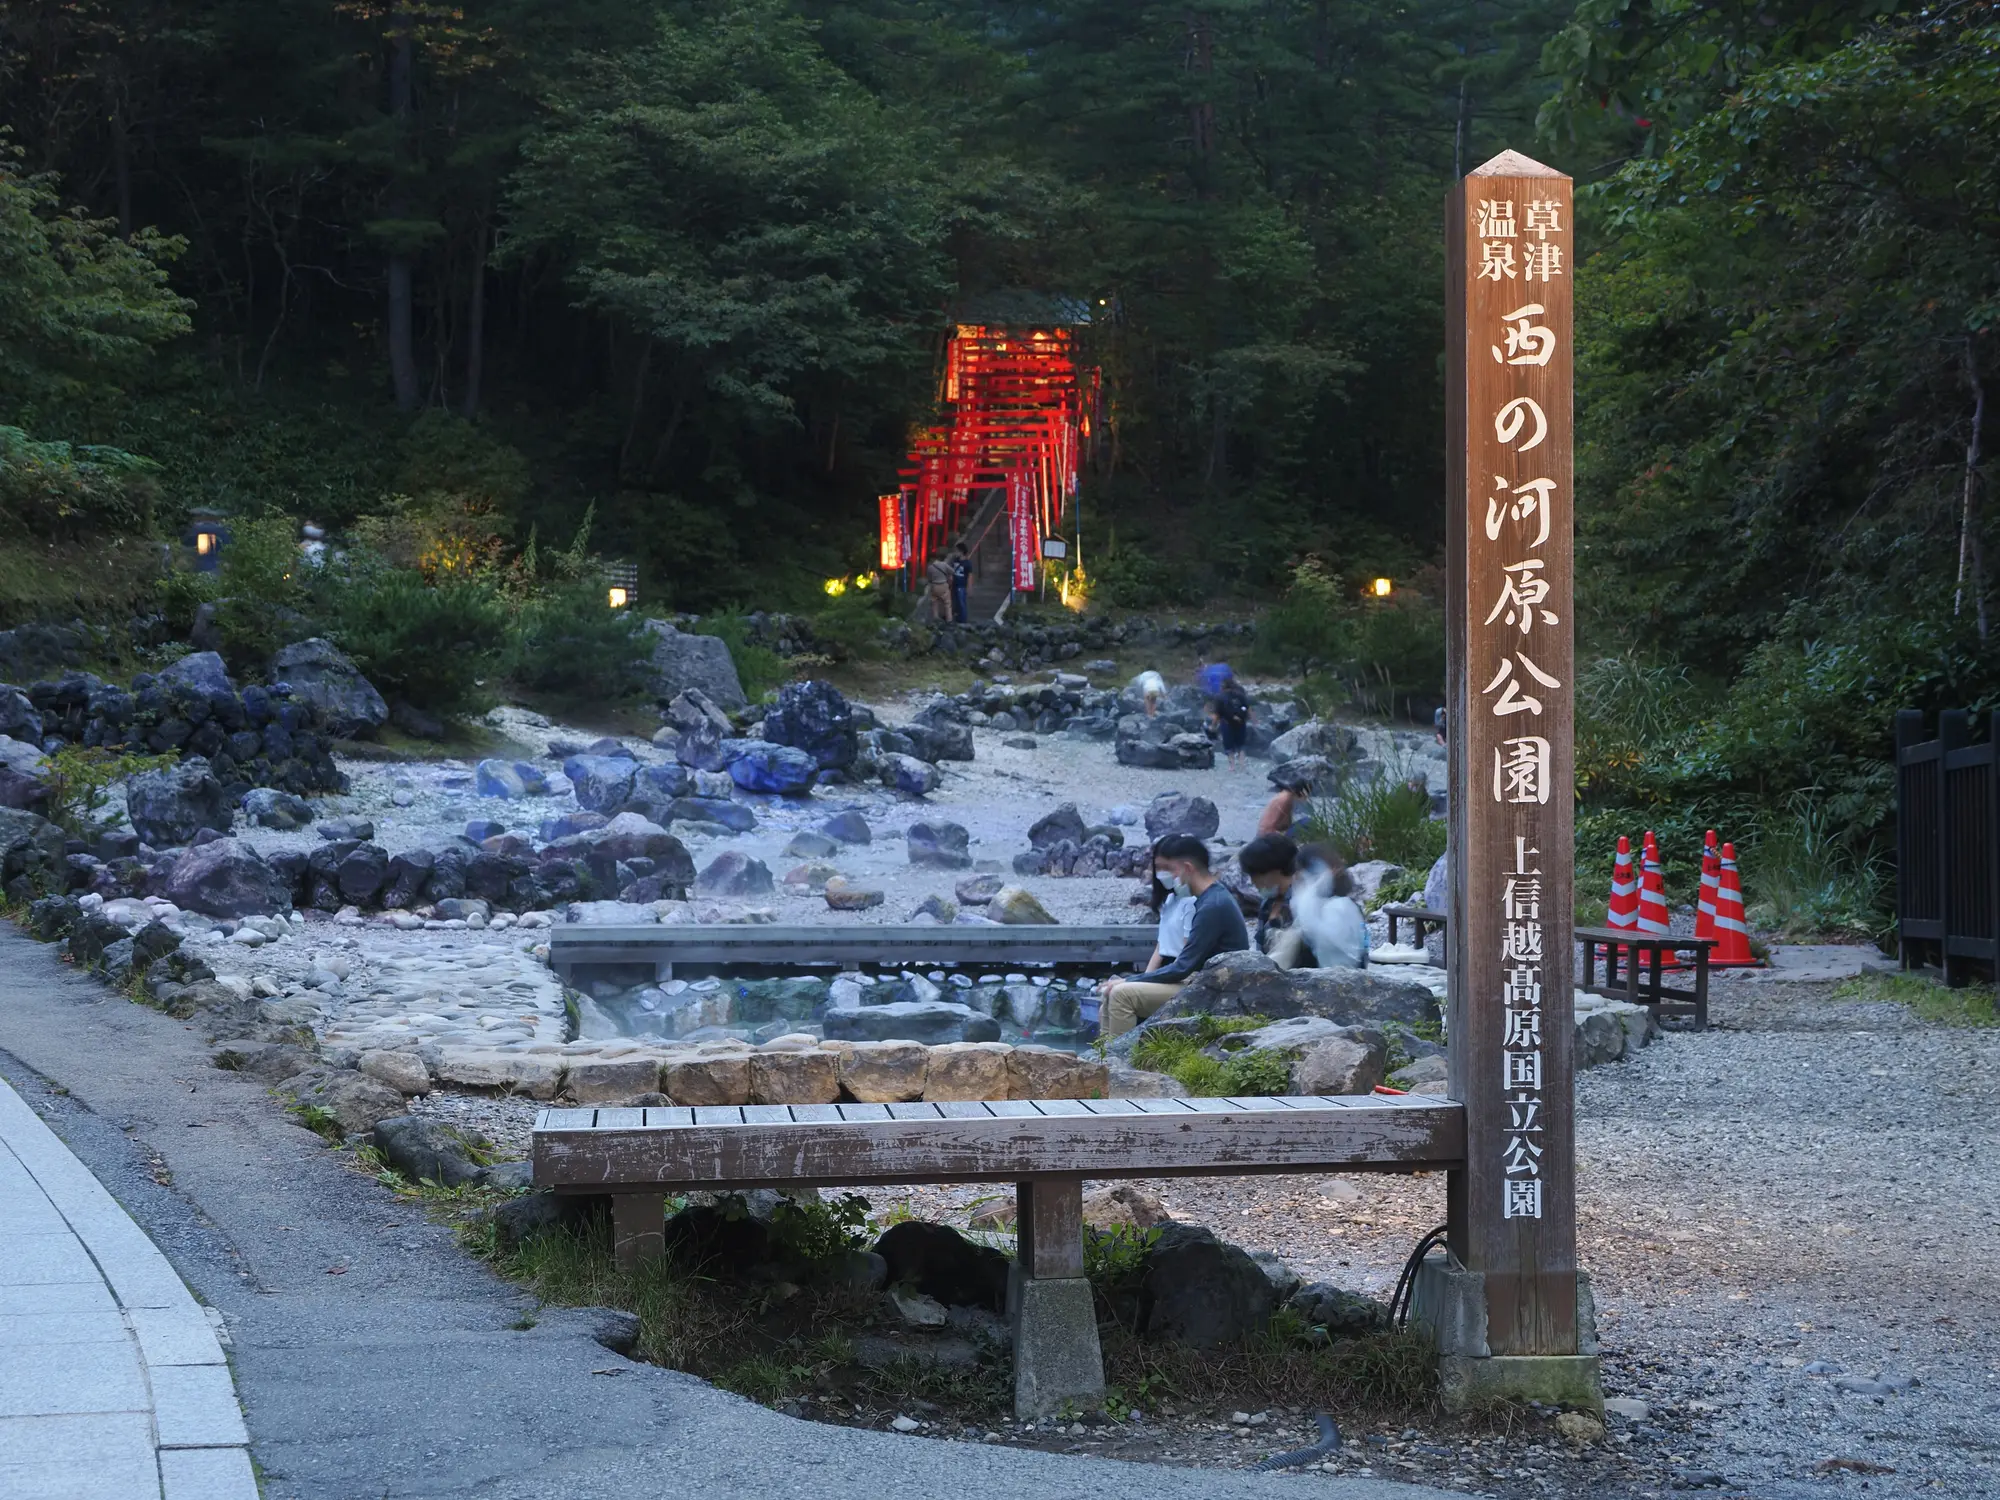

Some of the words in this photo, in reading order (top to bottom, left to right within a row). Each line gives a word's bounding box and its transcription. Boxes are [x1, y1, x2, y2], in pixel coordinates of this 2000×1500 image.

[1476, 199, 1519, 282] 温泉
[1523, 200, 1564, 283] 草津
[1481, 303, 1562, 806] 西の河原公園
